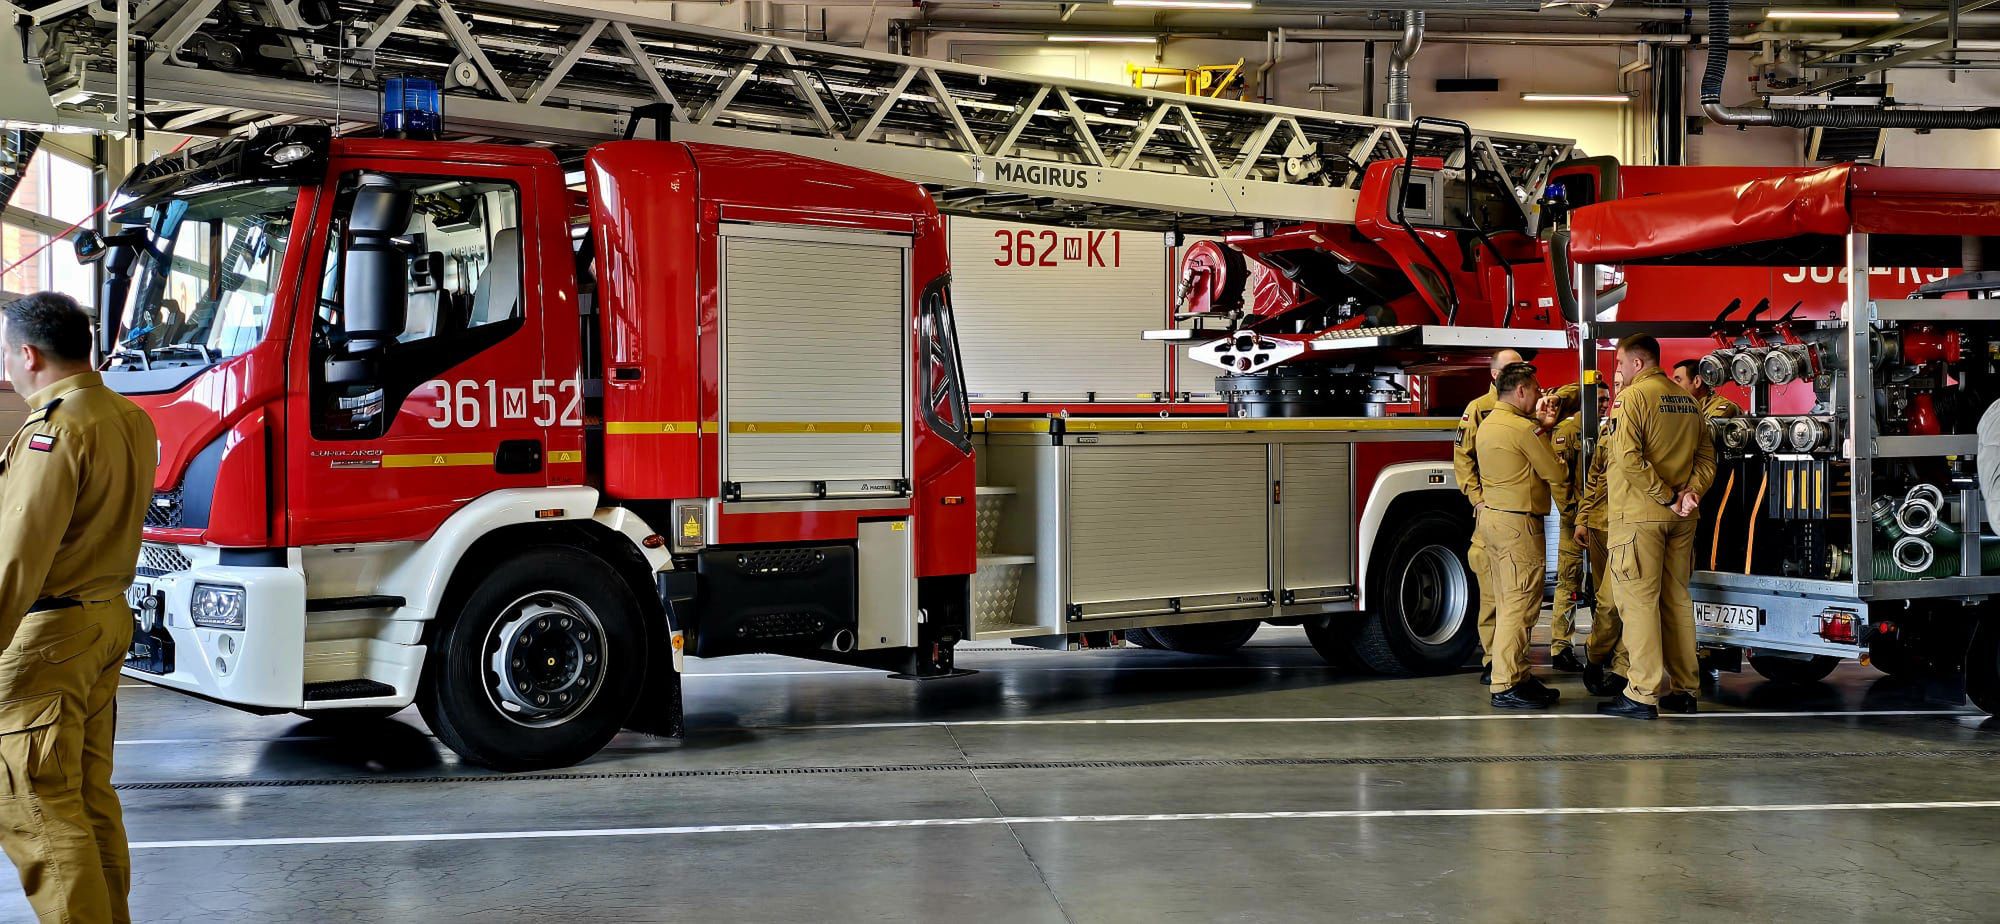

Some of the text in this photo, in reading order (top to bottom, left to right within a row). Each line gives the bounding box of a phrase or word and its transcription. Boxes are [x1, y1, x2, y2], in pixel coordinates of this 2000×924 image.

[995, 161, 1088, 189] MAGIRUS
[994, 229, 1121, 267] 362 M K1
[427, 379, 583, 428] 361 M 52
[1696, 603, 1754, 626] WE 727AS
